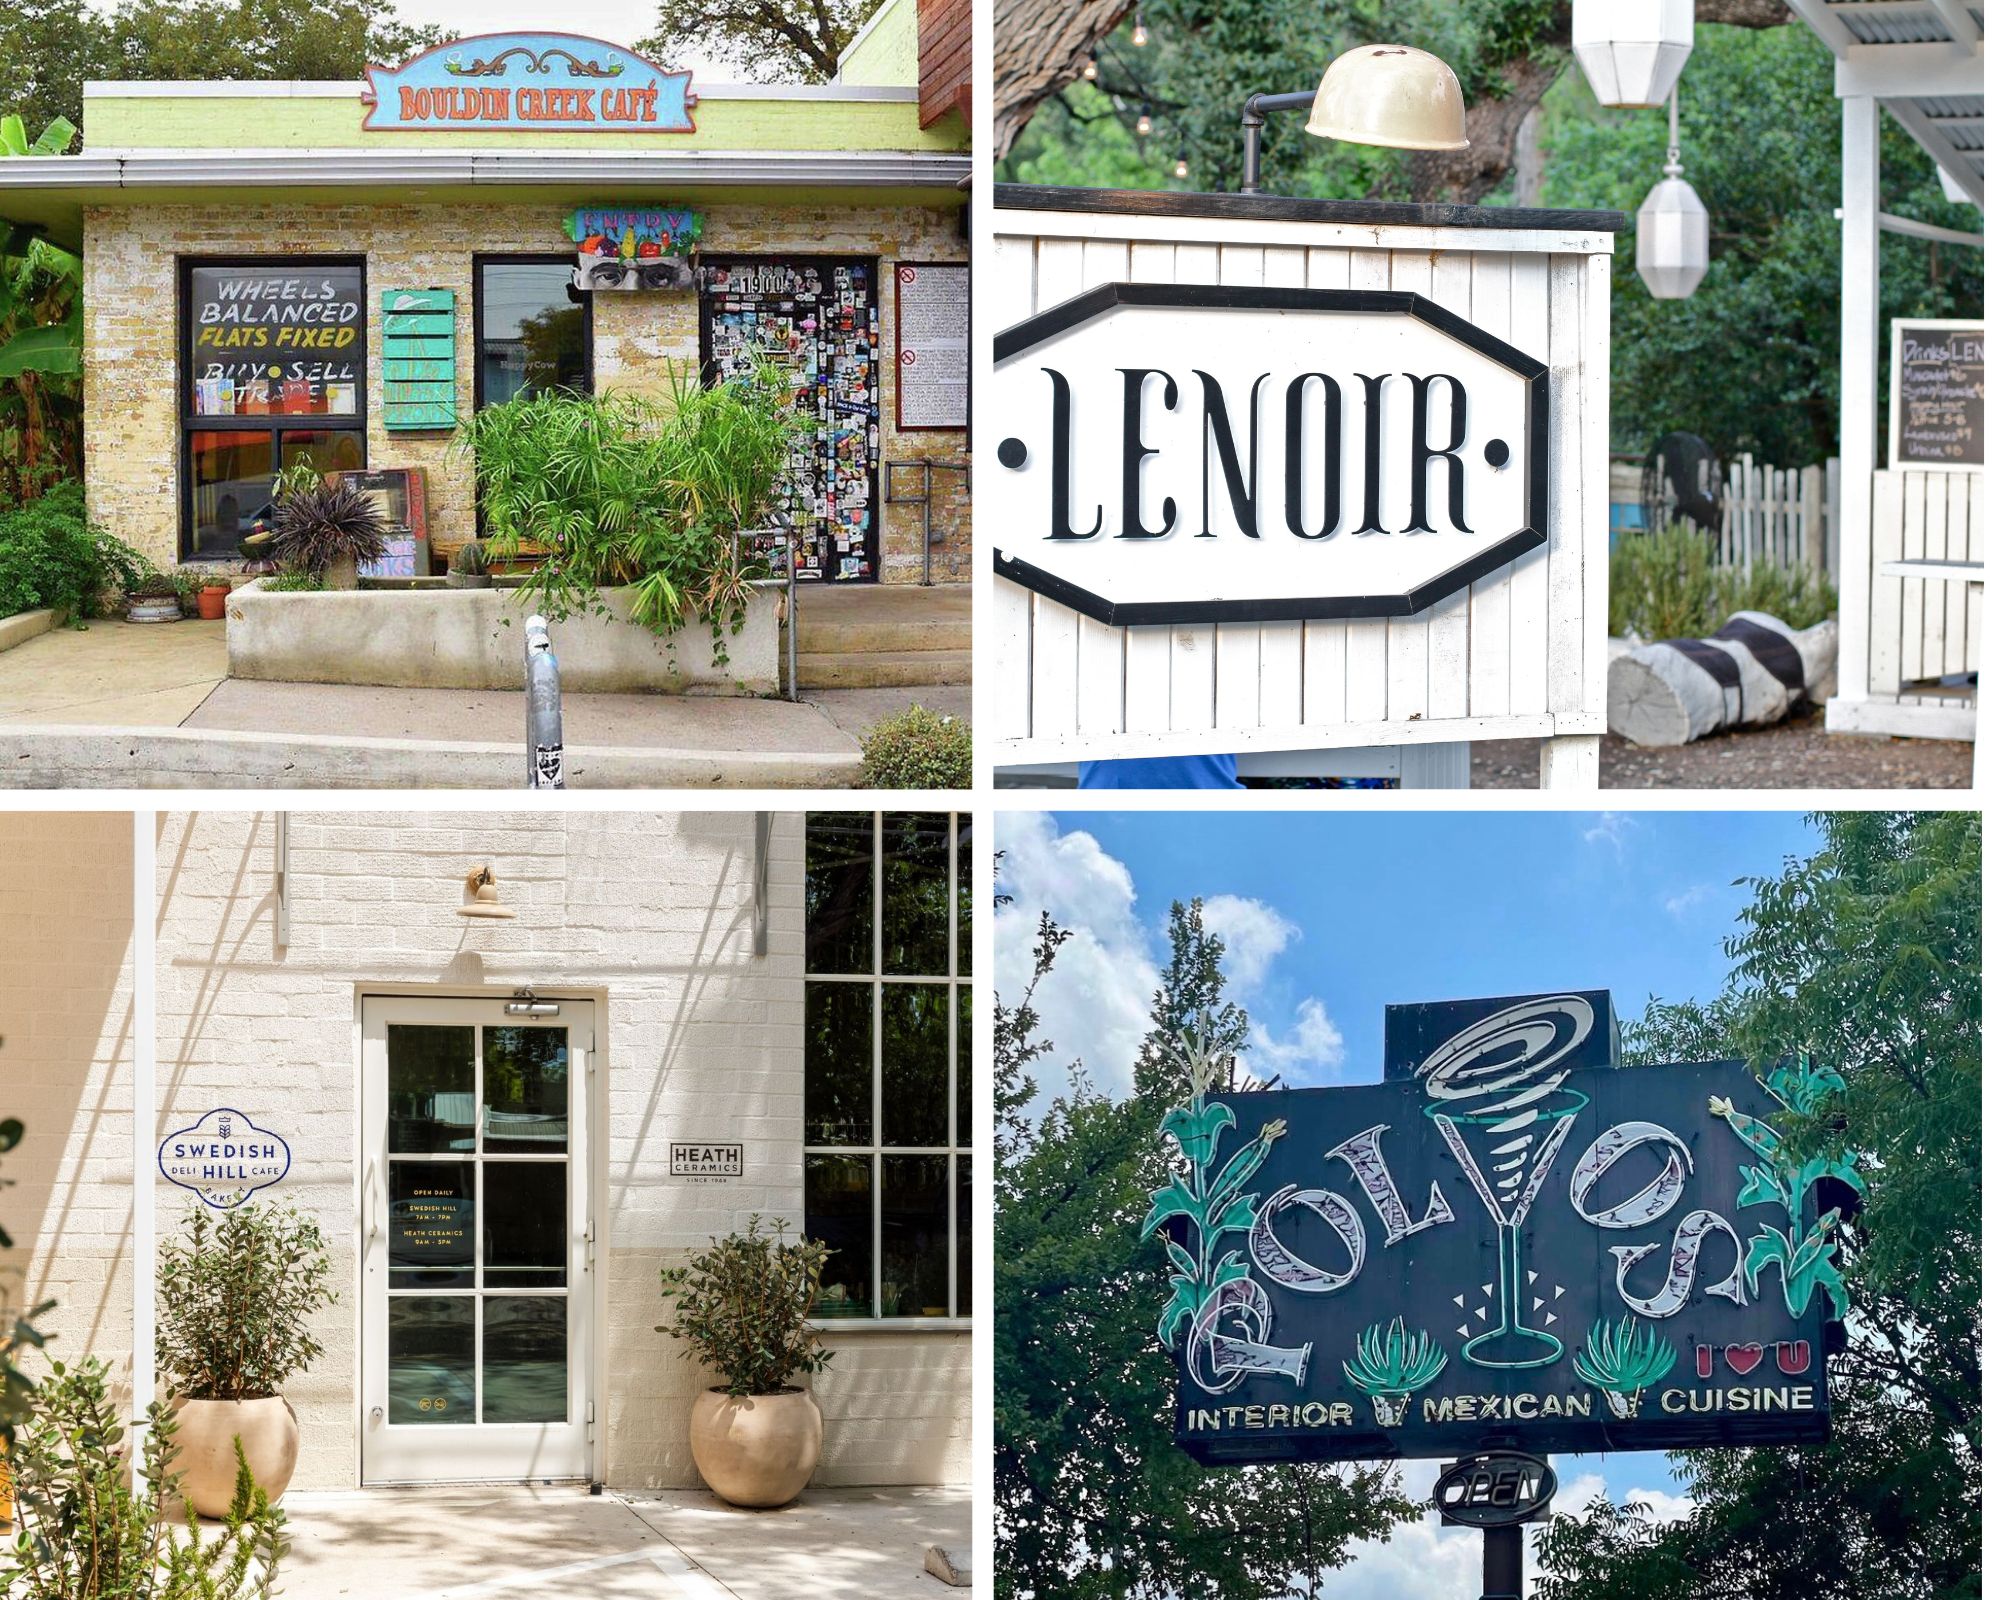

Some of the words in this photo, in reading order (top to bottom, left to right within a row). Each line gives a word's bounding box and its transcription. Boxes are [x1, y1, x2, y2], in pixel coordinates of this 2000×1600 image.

[399, 86, 510, 121] BOULDIN
[518, 86, 596, 121] CREEK
[601, 79, 658, 122] CAFÉ
[583, 211, 682, 235] ENTRY
[217, 279, 336, 301] WHEELS
[742, 277, 782, 292] 1900
[200, 302, 358, 324] BALANCED
[197, 327, 268, 348] FLATS
[275, 327, 357, 348] FIXED
[1903, 340, 1951, 363] Drinks
[287, 361, 353, 381] SELL
[1041, 367, 1474, 541] LENOIR
[175, 1144, 275, 1158] SWEDISH
[675, 1148, 738, 1162] HEATH
[171, 1167, 196, 1175] DELI
[203, 1165, 247, 1179] HILL
[251, 1167, 279, 1175] CAFE
[675, 1164, 738, 1172] CERAMICS
[1696, 1343, 1713, 1378] I
[1776, 1340, 1810, 1375] U
[1188, 1402, 1353, 1431] INTERIOR
[1423, 1390, 1591, 1424] MEXICAN
[1661, 1386, 1814, 1414] CUISINE
[1443, 1468, 1545, 1508] OPEN
